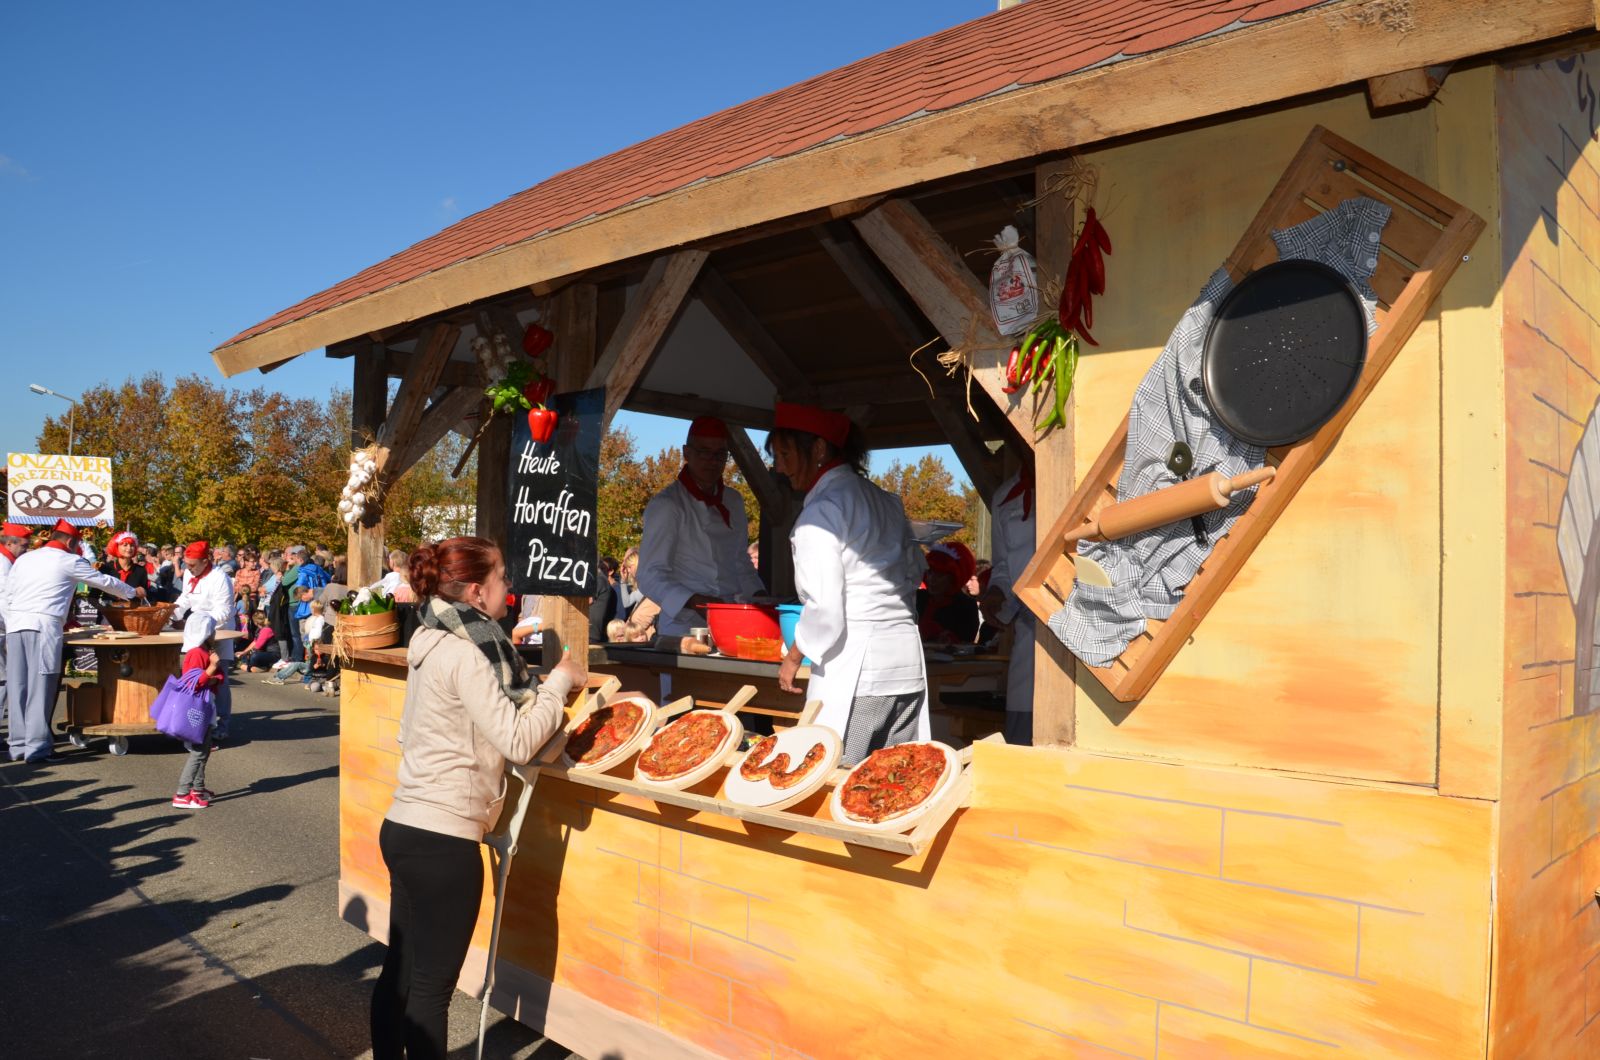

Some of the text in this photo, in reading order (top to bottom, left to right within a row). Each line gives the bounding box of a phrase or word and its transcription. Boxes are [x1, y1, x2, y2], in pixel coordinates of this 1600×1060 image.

[8, 453, 110, 473] ONZAMER
[518, 441, 560, 474] Heute
[9, 470, 111, 491] BREZENHAUS
[513, 486, 590, 537] Horaffen
[527, 539, 588, 588] Pizza
